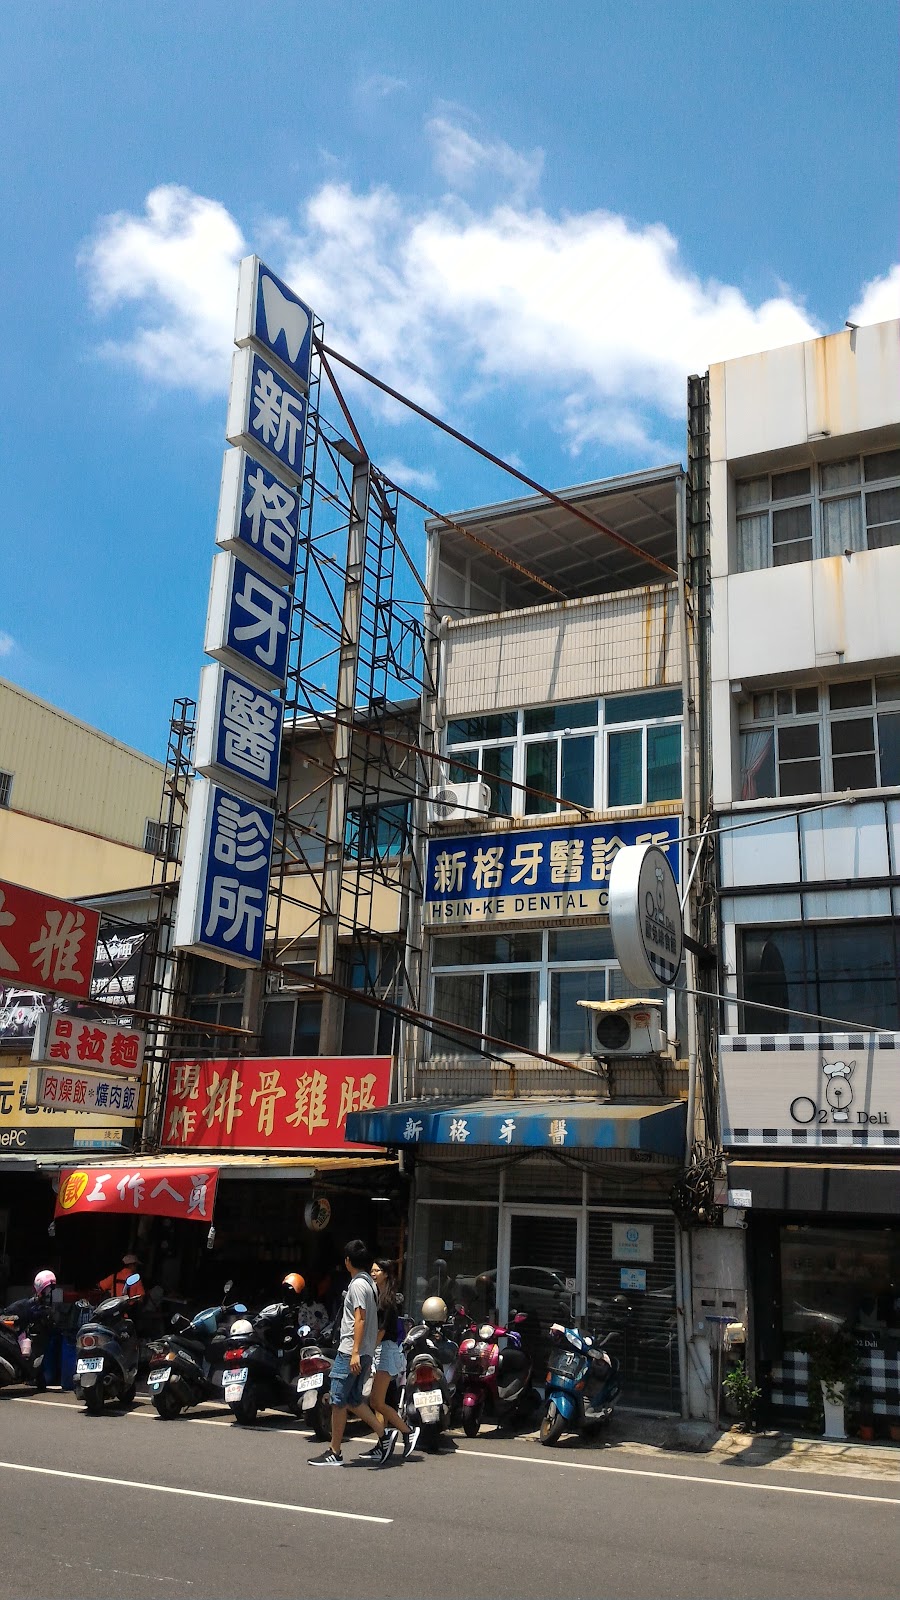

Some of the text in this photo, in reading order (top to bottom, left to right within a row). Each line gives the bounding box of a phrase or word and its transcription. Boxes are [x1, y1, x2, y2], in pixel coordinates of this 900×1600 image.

[204, 368, 304, 951] 新格牙醫診所
[432, 899, 505, 918] HSIN-KE
[514, 894, 588, 912] DENTAL
[856, 1111, 889, 1124] Deli
